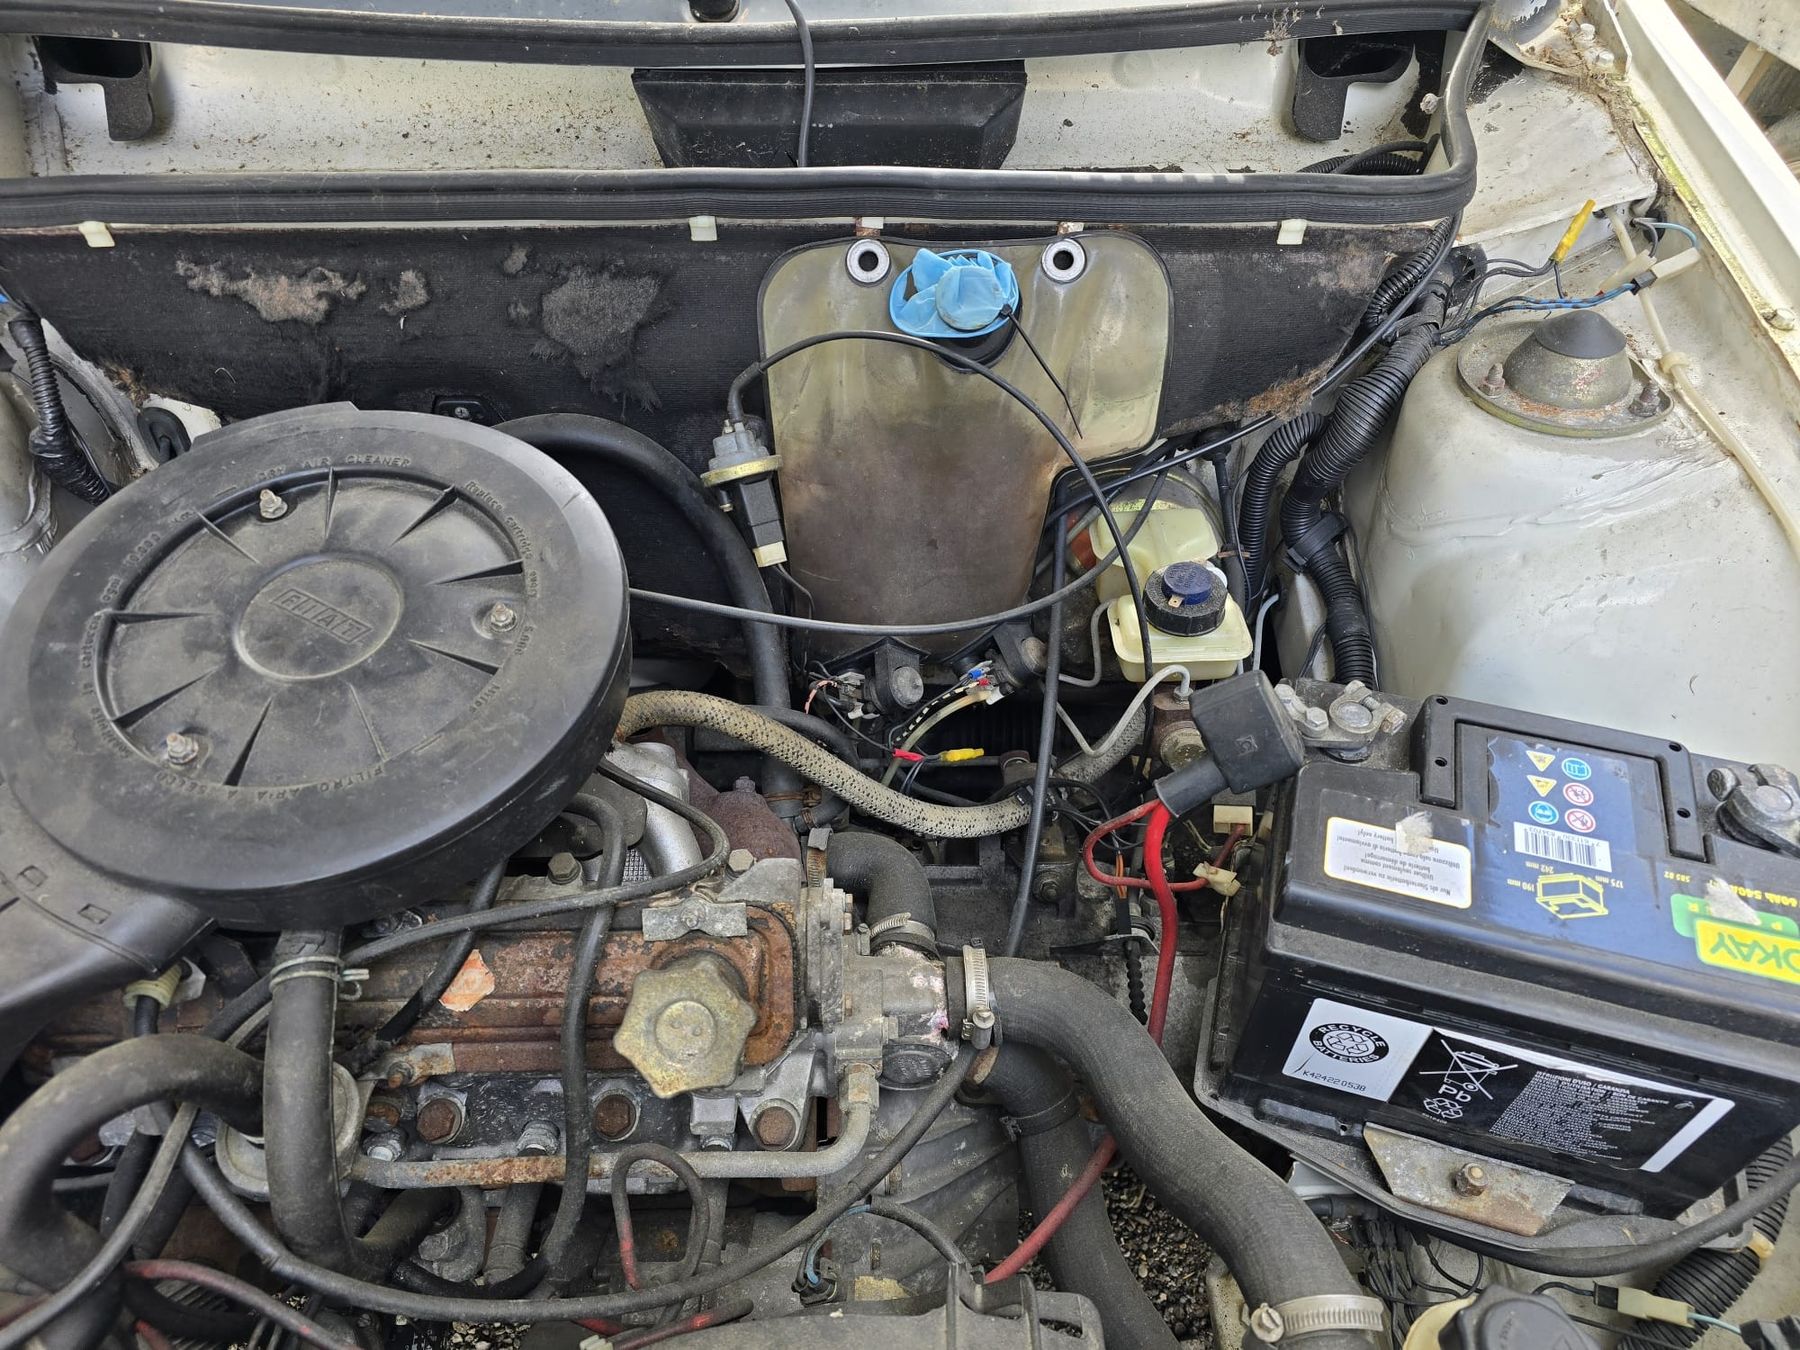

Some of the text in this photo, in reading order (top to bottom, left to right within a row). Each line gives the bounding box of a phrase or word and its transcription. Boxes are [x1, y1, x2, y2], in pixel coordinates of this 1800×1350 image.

[303, 456, 331, 469] AIR
[345, 454, 412, 468] CLEANER
[279, 591, 364, 639] FIAT
[319, 763, 384, 793] FILTRO
[227, 789, 240, 800] A
[256, 786, 301, 801] ARIA
[1525, 861, 1554, 874] 242 mm
[1507, 878, 1535, 892] 190 mm
[1595, 875, 1624, 889] 175 mm
[1710, 931, 1800, 974] OKAY
[1317, 1024, 1386, 1048] RECYCLE
[1312, 1040, 1380, 1063] BATTERIES
[1438, 1084, 1472, 1102] Pb
